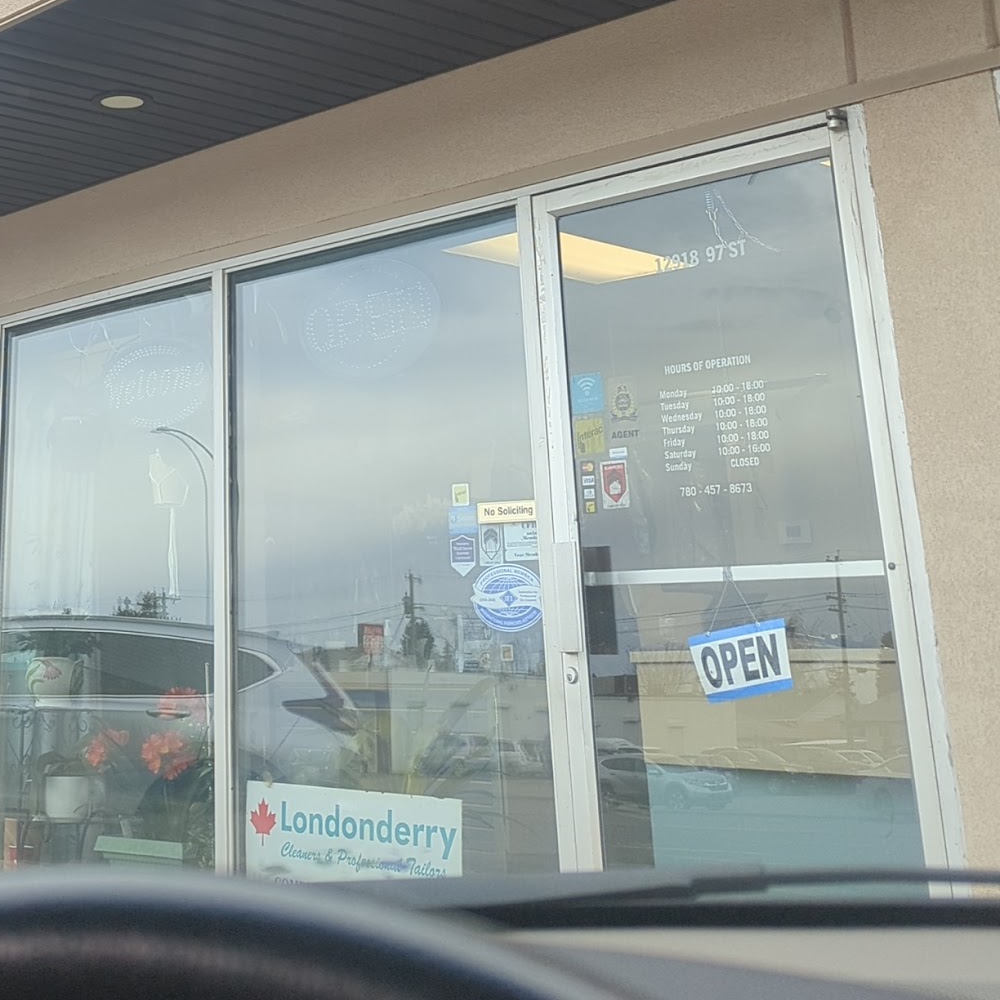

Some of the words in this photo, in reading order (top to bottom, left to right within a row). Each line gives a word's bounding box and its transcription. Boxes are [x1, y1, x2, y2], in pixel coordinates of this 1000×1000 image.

[654, 250, 699, 272] 12918
[706, 244, 724, 263] 97
[729, 239, 746, 258] ST
[664, 363, 692, 375] HOURS
[693, 361, 703, 371] OF
[705, 354, 751, 369] OPERATION
[660, 389, 687, 400] Monday
[742, 380, 764, 390] 18:00
[660, 401, 690, 411] Tuesday
[713, 396, 736, 406] 10:00
[743, 392, 765, 403] 18:00
[661, 412, 702, 423] Wednesday
[715, 408, 737, 418] 10:00
[744, 405, 767, 415] 18:00
[612, 429, 639, 439] AGENT
[662, 425, 695, 435] Thursday
[716, 420, 738, 431] 10:00
[745, 417, 768, 428] 18:00
[663, 438, 685, 448] Friday
[717, 433, 739, 443] 10:00
[747, 430, 769, 440] 18:00
[664, 449, 696, 460] Saturday
[718, 445, 740, 456] 10:00
[748, 443, 771, 453] 16:00
[665, 462, 692, 472] Sunday
[730, 457, 760, 468] CLOSED
[680, 486, 697, 497] 780
[704, 484, 721, 495] 457
[729, 482, 752, 494] 8673
[484, 508, 495, 516] No
[497, 506, 533, 516] Soliciting
[701, 633, 782, 689] OPEN
[281, 801, 457, 860] Londonderry
[281, 841, 321, 861] Cleaners
[325, 848, 333, 861] &
[406, 858, 448, 879] Tailors
